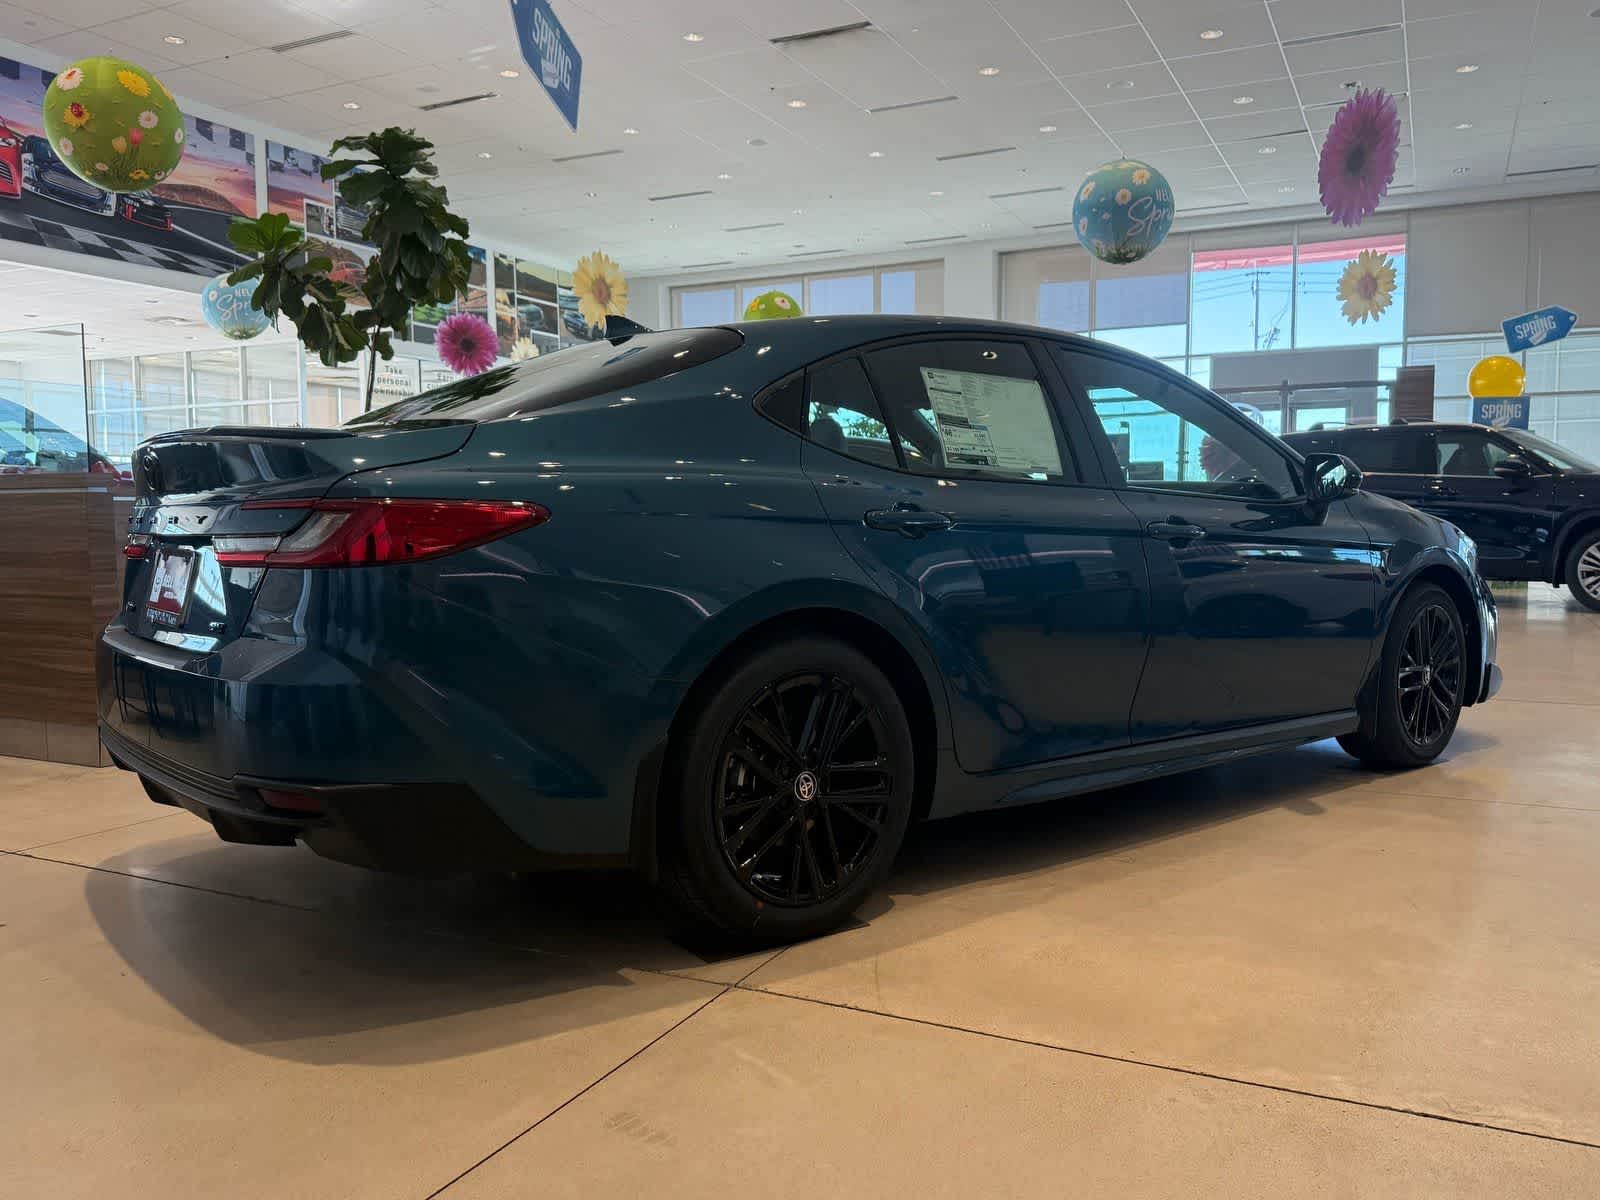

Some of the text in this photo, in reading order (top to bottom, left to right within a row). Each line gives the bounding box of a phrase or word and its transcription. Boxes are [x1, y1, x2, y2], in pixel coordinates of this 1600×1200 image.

[385, 365, 402, 374] Take
[377, 377, 411, 387] personal
[1481, 400, 1522, 418] SPRING
